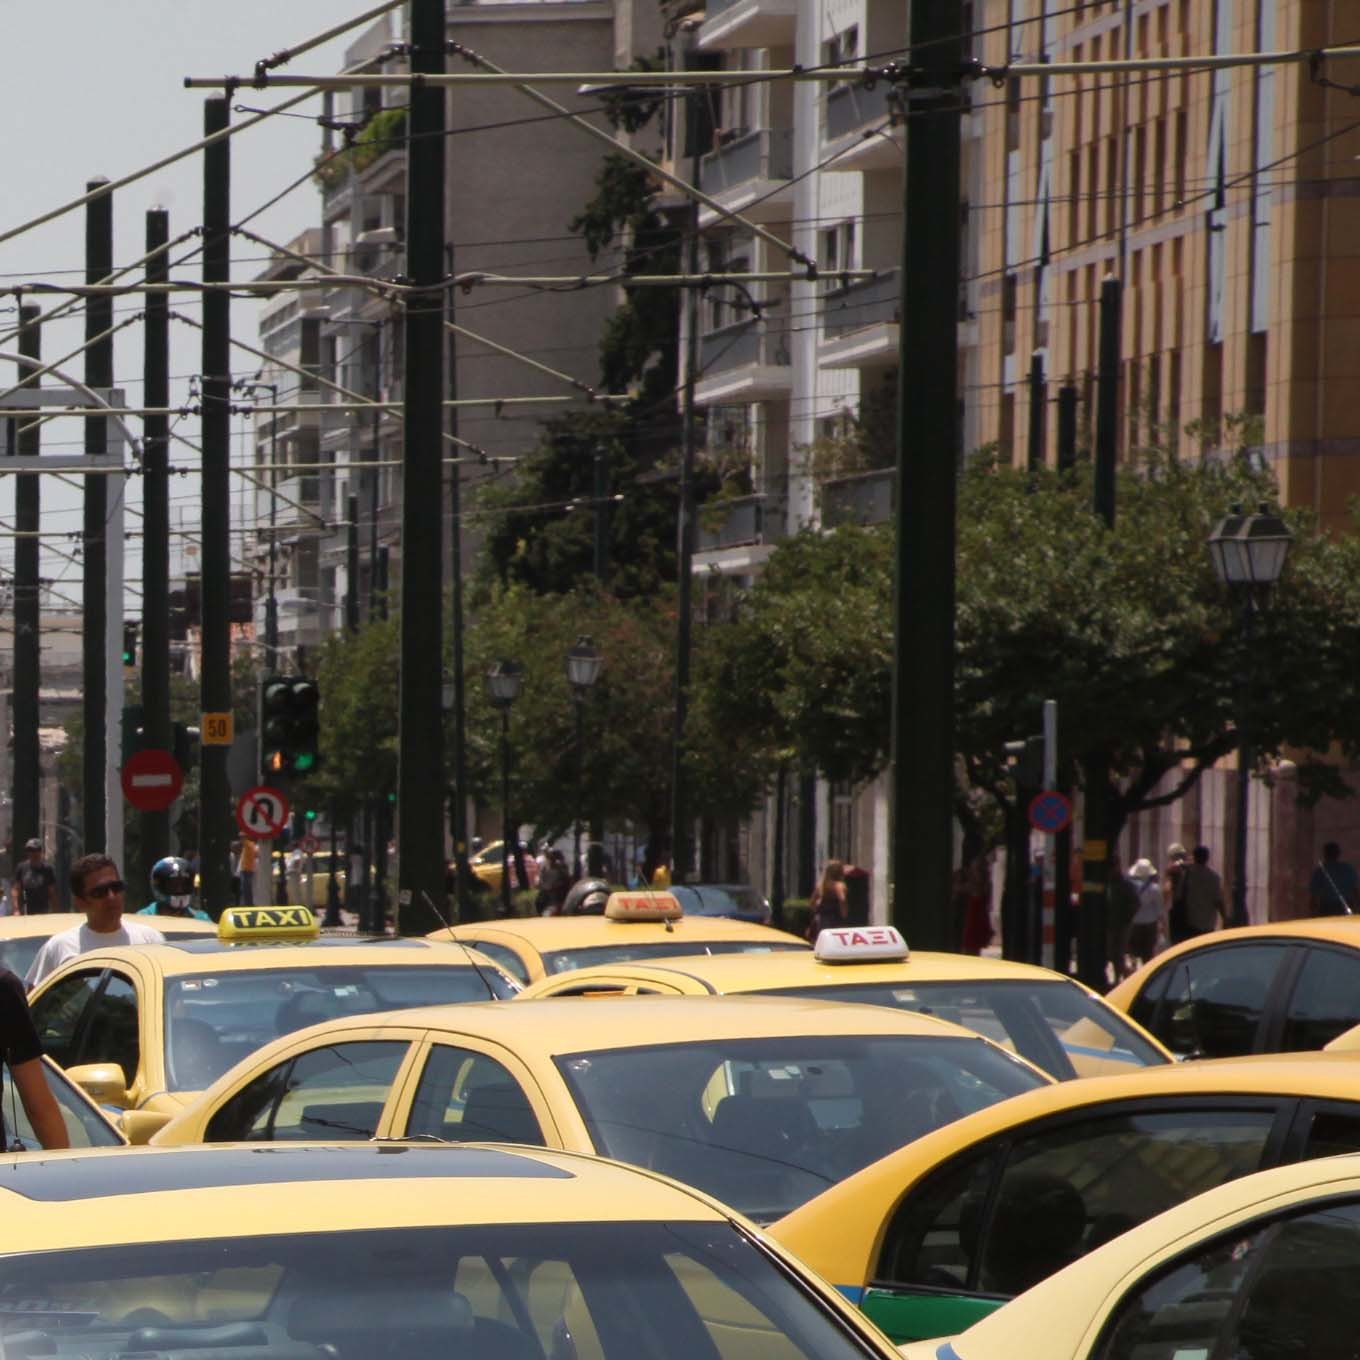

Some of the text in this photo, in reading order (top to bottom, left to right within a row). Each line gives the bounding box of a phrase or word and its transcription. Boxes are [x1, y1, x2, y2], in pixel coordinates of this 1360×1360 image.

[208, 719, 227, 738] 50
[618, 898, 677, 910] ΤΑΞΙ
[231, 910, 309, 927] TAXI
[832, 930, 898, 945] ΤΑΞΙ
